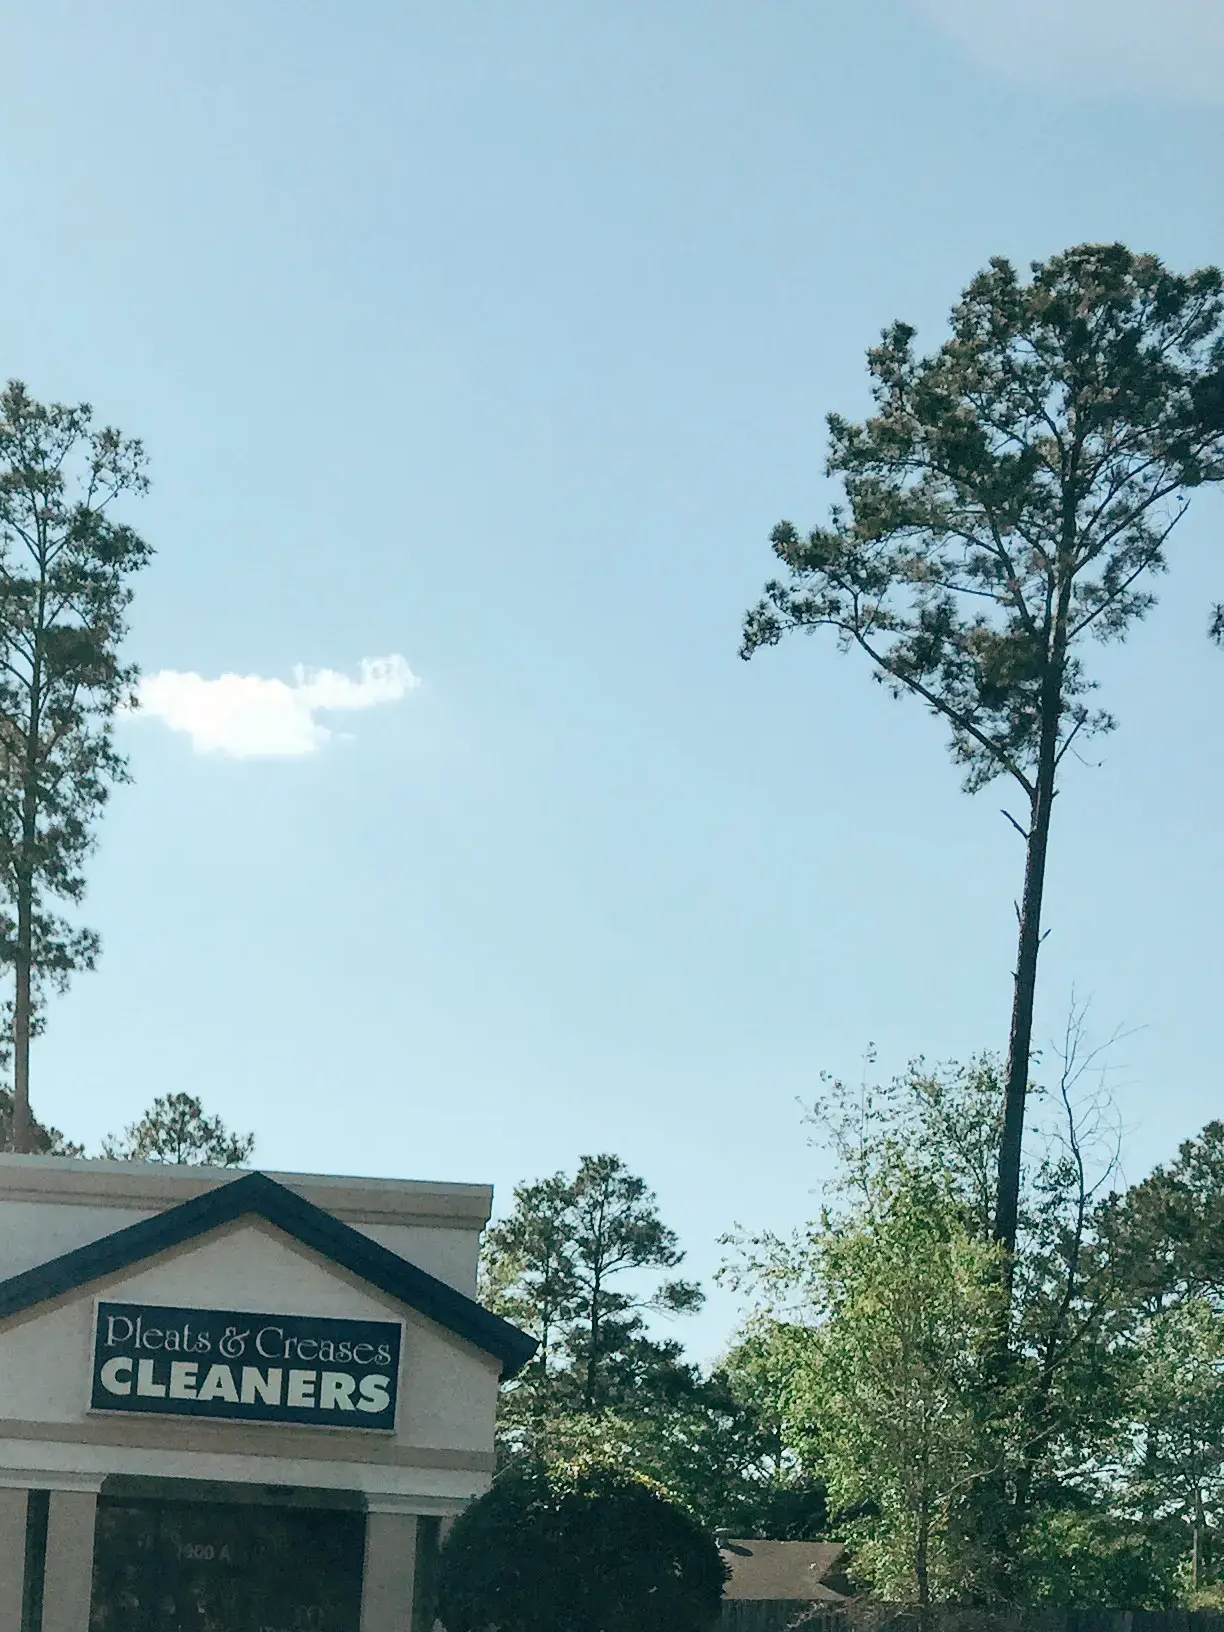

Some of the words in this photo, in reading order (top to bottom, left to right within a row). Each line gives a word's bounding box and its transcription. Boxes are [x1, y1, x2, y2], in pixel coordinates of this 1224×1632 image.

[105, 1314, 210, 1353] Pleats
[219, 1327, 250, 1359] &
[256, 1326, 392, 1366] Creases
[100, 1356, 391, 1414] CLEANERS
